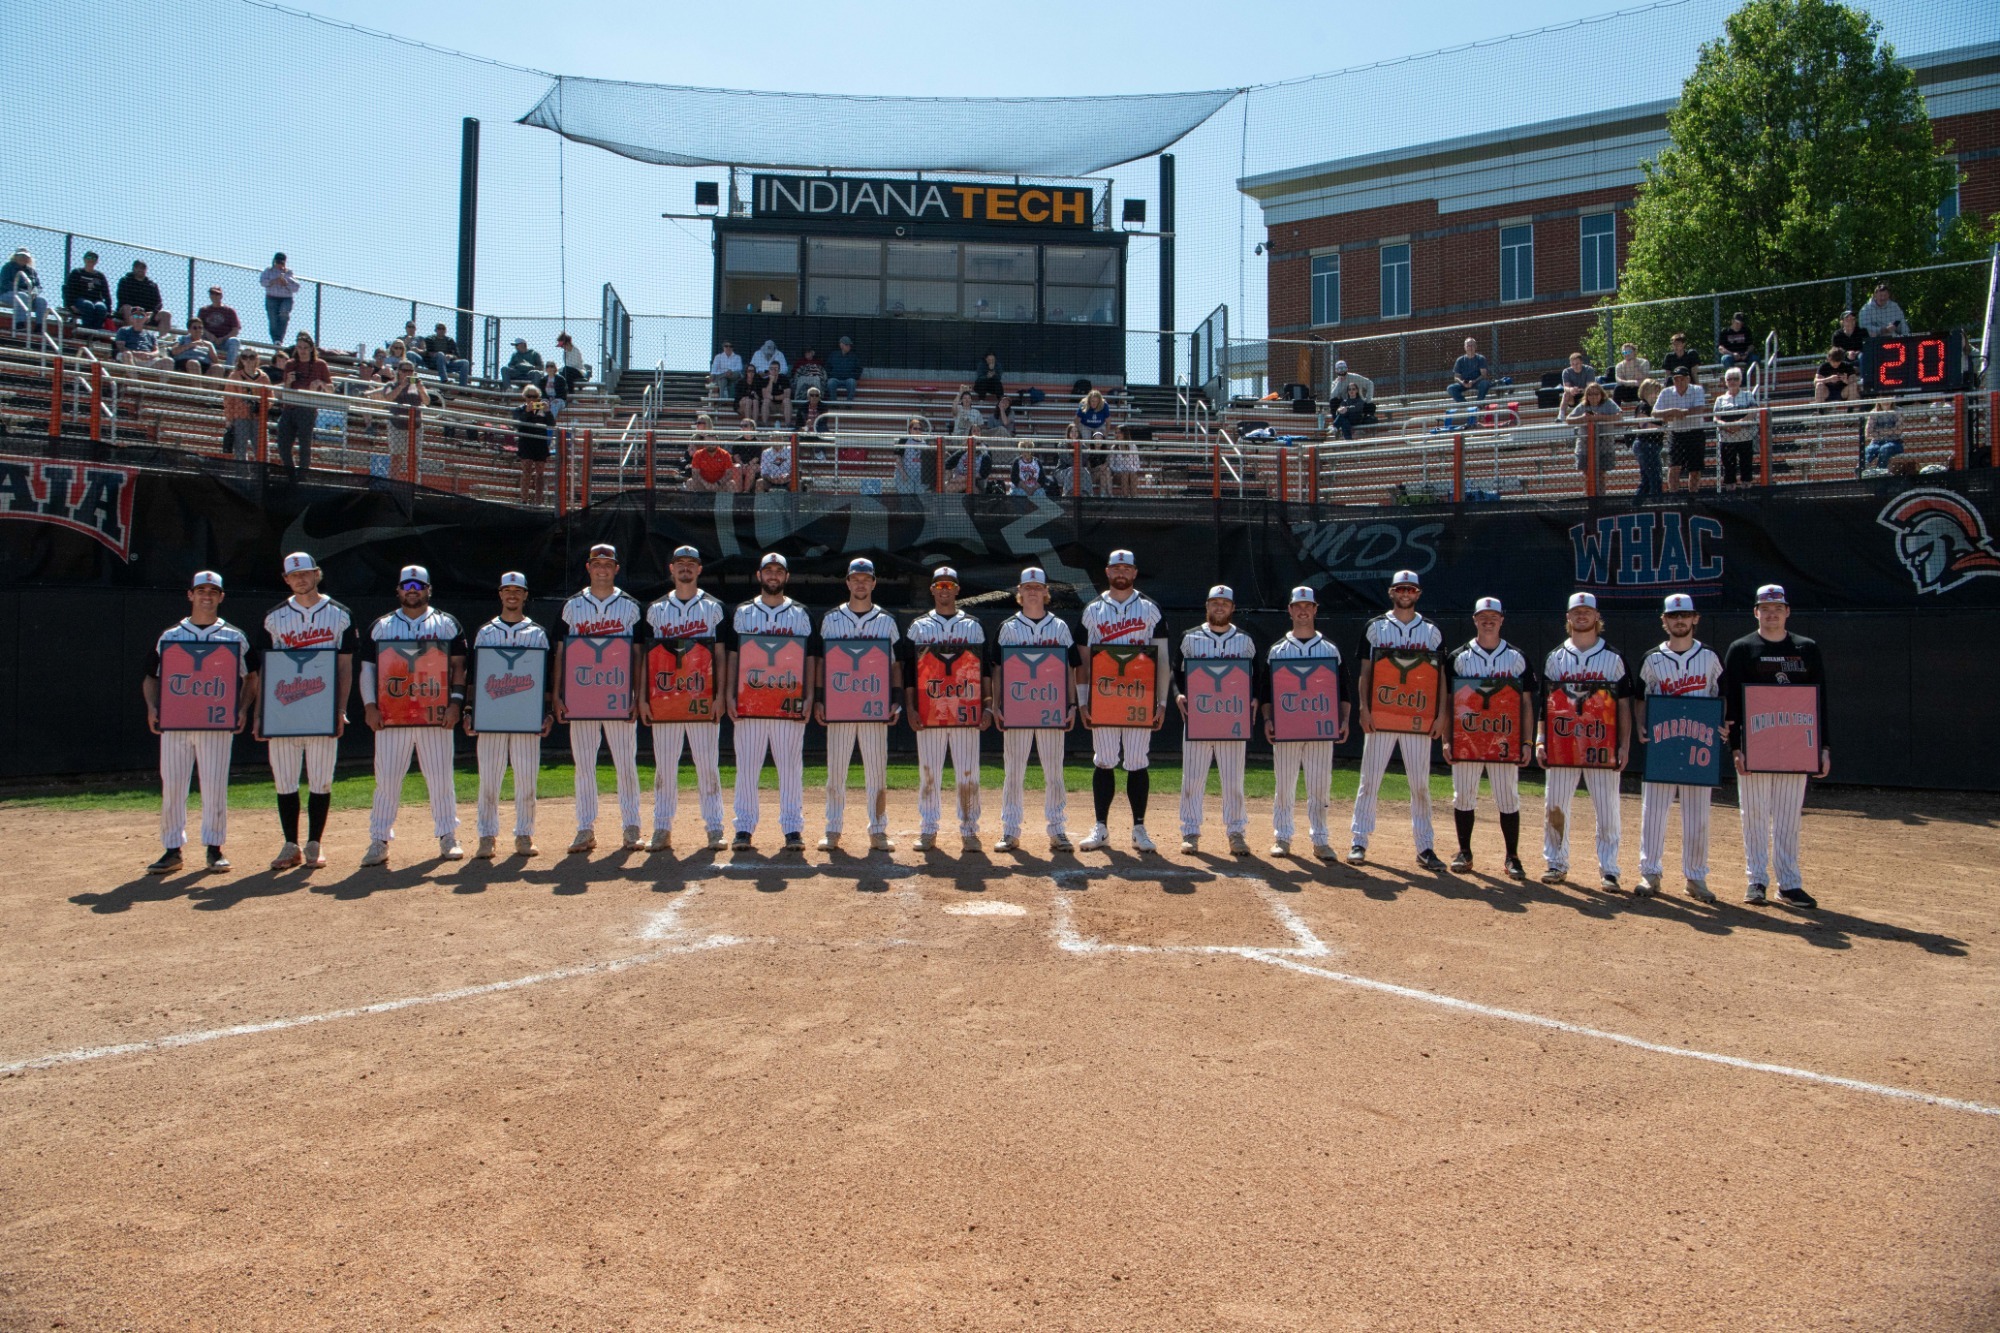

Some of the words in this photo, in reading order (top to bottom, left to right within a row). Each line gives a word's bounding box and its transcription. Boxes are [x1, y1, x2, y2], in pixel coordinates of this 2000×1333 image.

[759, 179, 949, 218] INDIANA
[952, 186, 1085, 224] TECH
[1880, 339, 1945, 385] 20
[1291, 522, 1445, 573] MDS
[1569, 511, 1723, 585] WHAC
[576, 618, 625, 635] Warriors
[660, 619, 708, 637] Warriors
[1097, 616, 1146, 641] Warriors
[281, 627, 334, 648] Warriors
[168, 673, 225, 700] Tech
[575, 666, 625, 687] Tech
[656, 671, 705, 693] Tech
[747, 669, 797, 691] Tech
[832, 671, 880, 694] Tech
[1659, 673, 1707, 695] Warriors
[385, 676, 441, 699] Tech
[926, 679, 974, 699] Tech
[1010, 681, 1058, 703] Tech
[1097, 676, 1146, 699] Tech
[607, 694, 626, 709] 21
[689, 698, 709, 714] 45
[862, 700, 883, 717] 43
[1196, 694, 1243, 716] Tech
[1281, 693, 1330, 715] Tech
[1378, 685, 1427, 712] Tech
[207, 706, 226, 724] 12
[427, 705, 446, 722] 19
[958, 706, 977, 722] 51
[1041, 709, 1061, 725] 24
[1126, 706, 1147, 722] 39
[1412, 716, 1423, 731] 9
[1461, 712, 1512, 735] Tech
[1793, 713, 1813, 726] TECH
[1232, 722, 1241, 736] 4
[1315, 720, 1335, 736] 10
[1553, 716, 1606, 740] Tech
[1653, 718, 1714, 746] WARRIORS
[1806, 730, 1813, 747] 1
[1499, 742, 1509, 758] 3
[1689, 746, 1711, 766] 10
